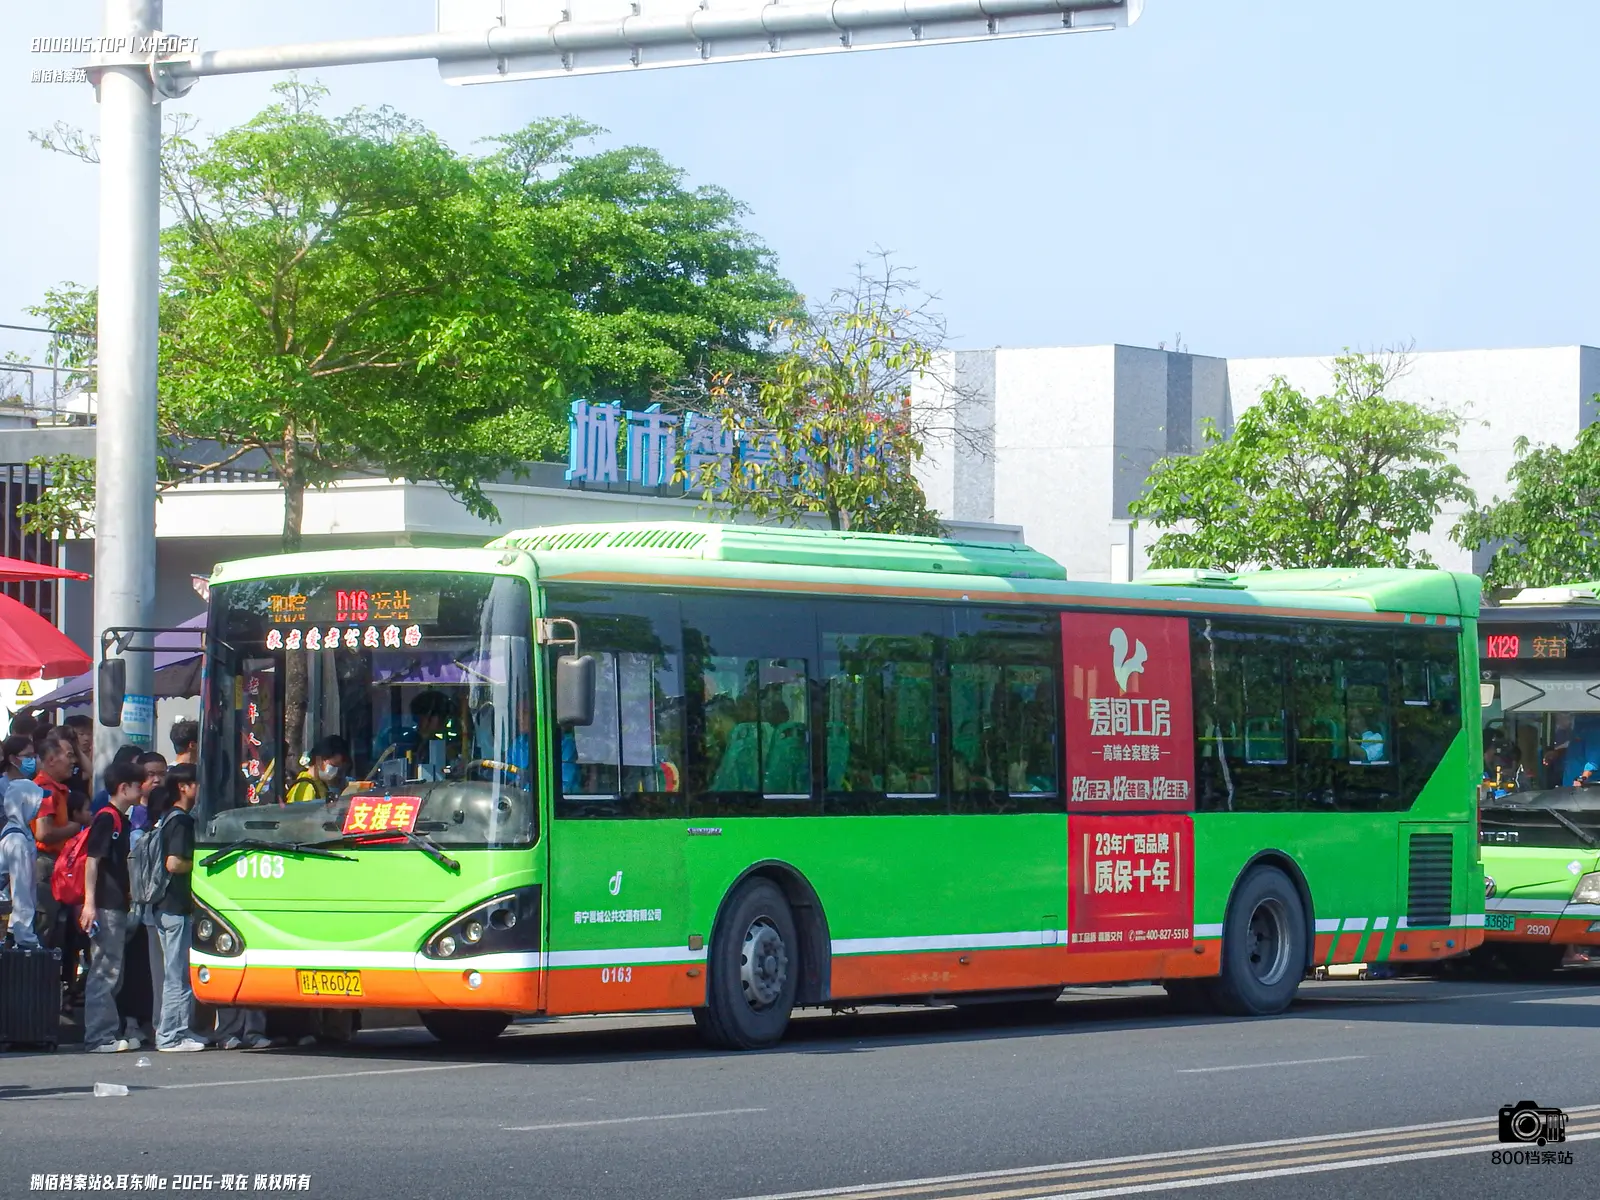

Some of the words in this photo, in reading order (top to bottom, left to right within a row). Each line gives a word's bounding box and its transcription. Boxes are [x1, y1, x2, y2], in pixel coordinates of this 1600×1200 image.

[266, 624, 422, 650] 敬老爱老公交线路
[1487, 634, 1520, 659] K129
[1089, 697, 1171, 736] 爱阁工房
[247, 675, 261, 804] 老年人优先
[348, 801, 414, 831] 支援车
[1095, 832, 1170, 856] 23年广西品牌
[236, 855, 285, 879] 0163
[1094, 858, 1171, 894] 质保十年
[1146, 928, 1189, 940] 400-827-5518
[1527, 924, 1551, 935] 2920
[601, 966, 633, 984] 0163
